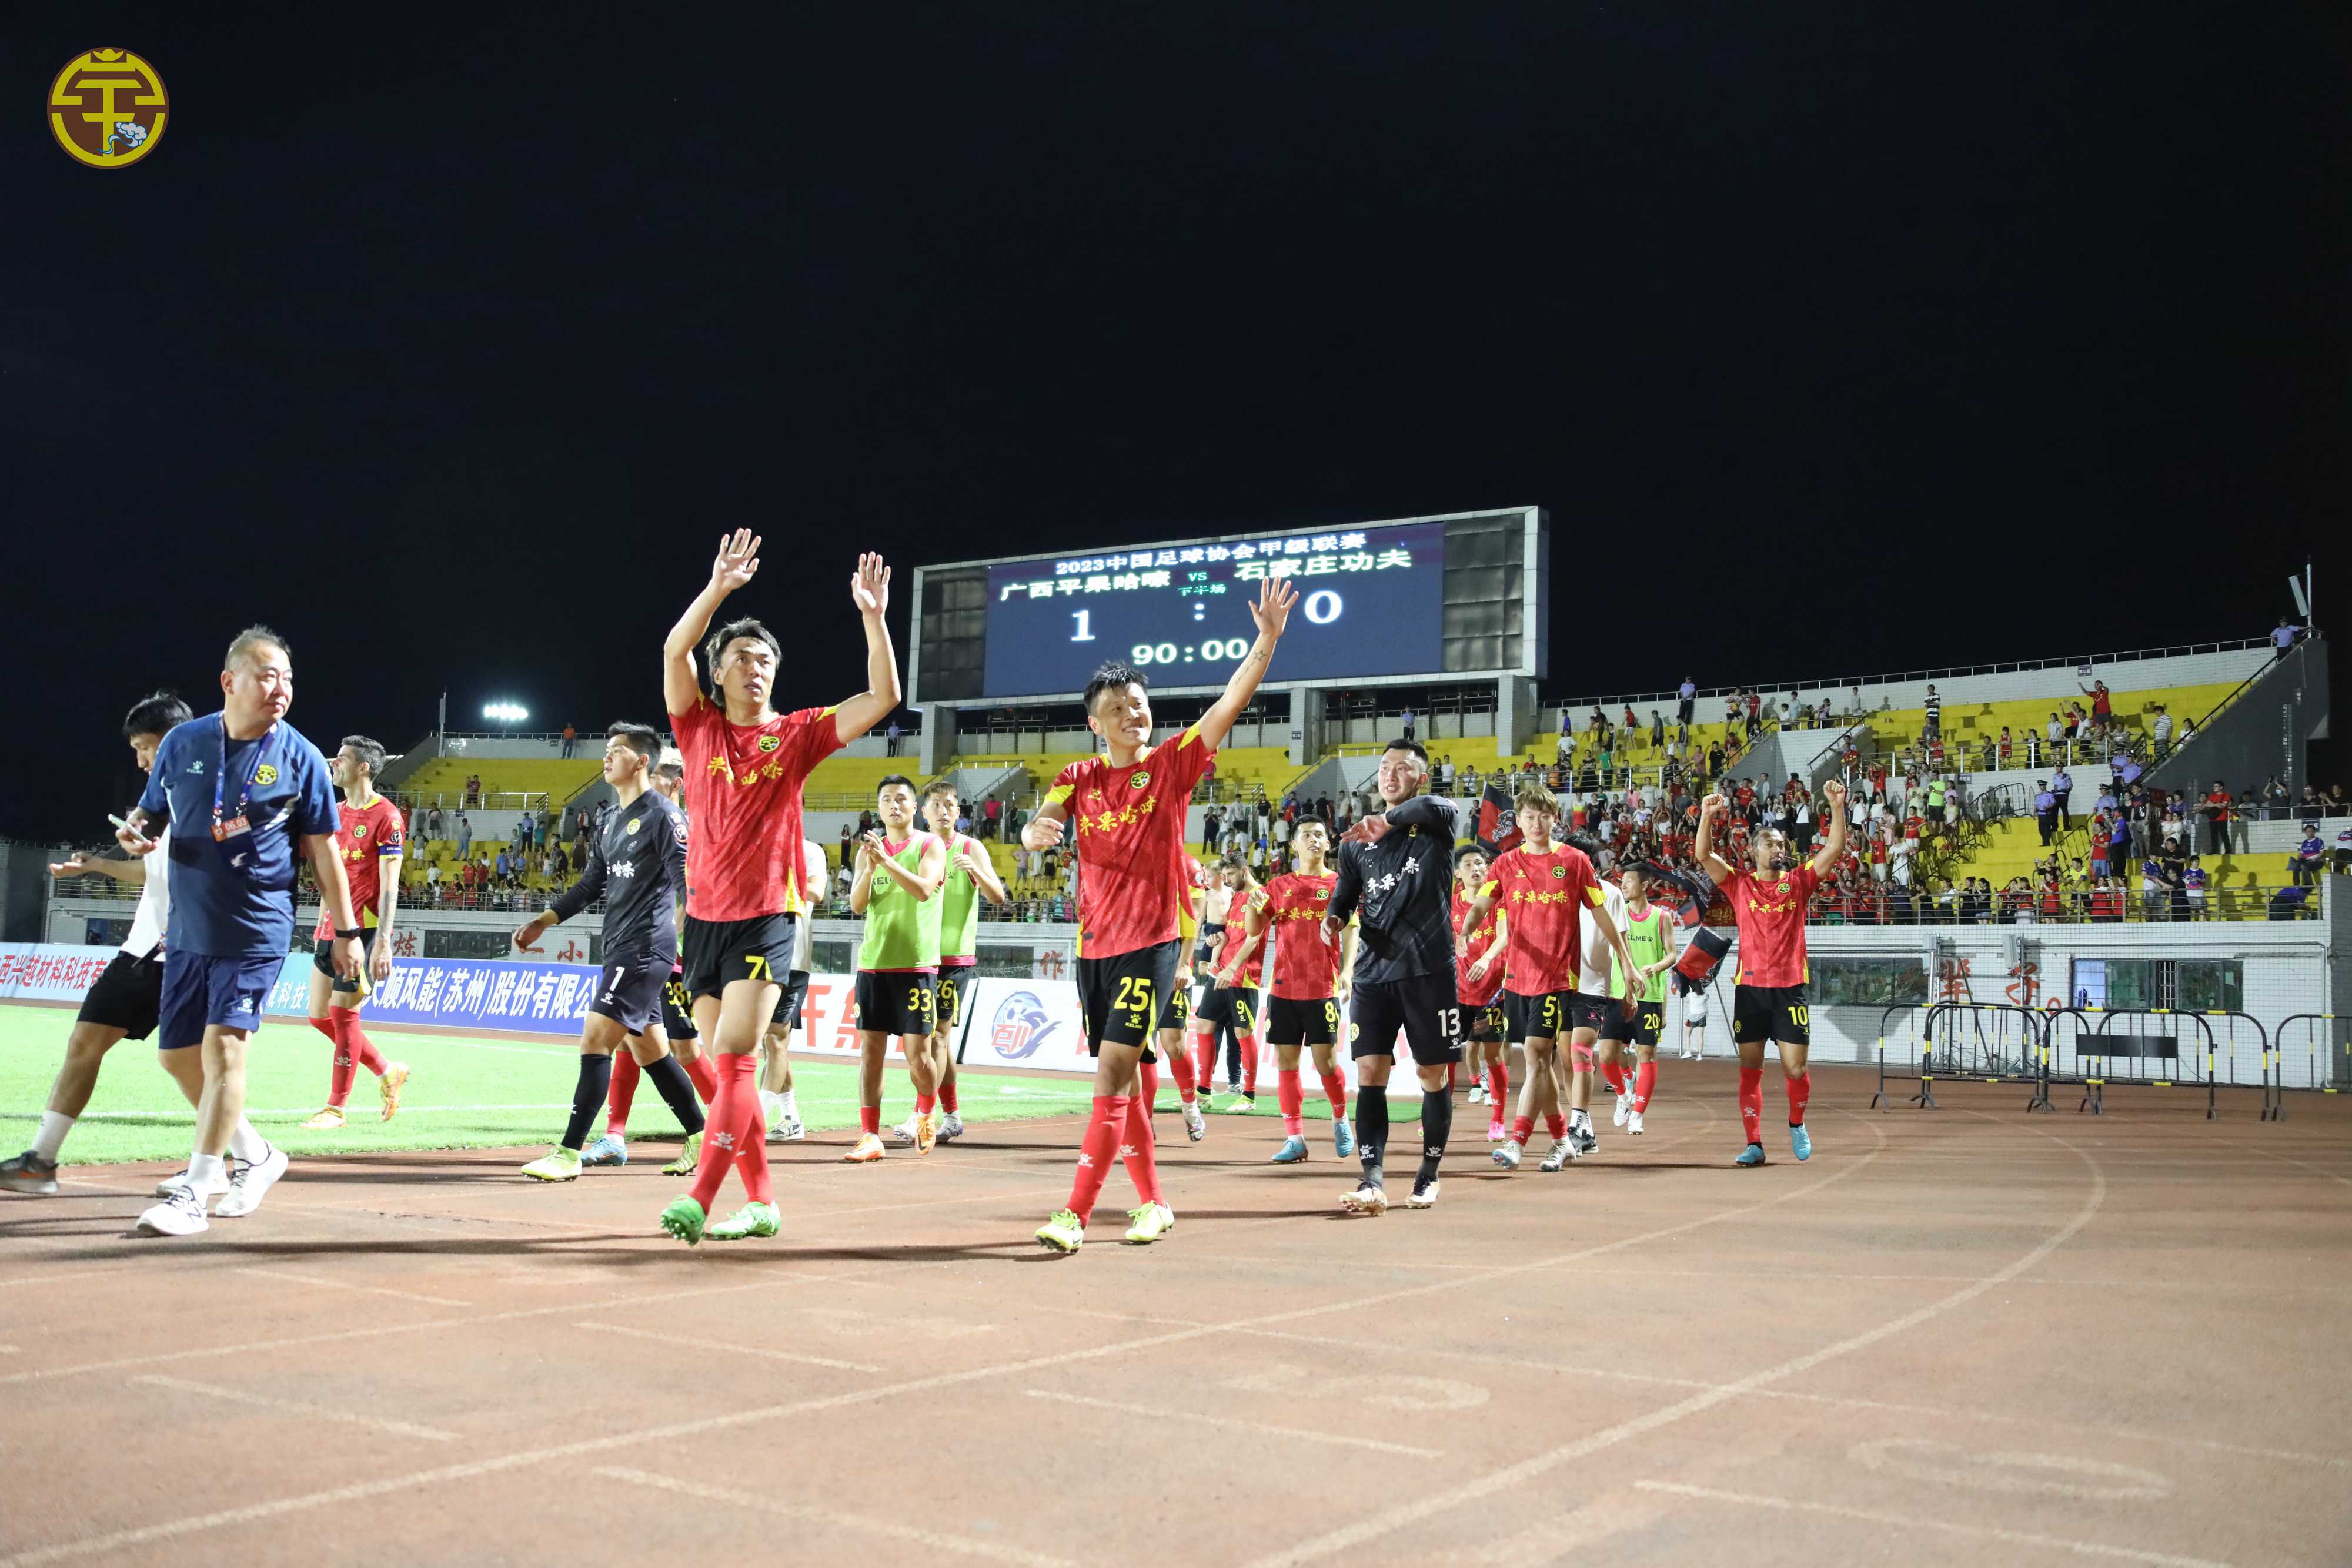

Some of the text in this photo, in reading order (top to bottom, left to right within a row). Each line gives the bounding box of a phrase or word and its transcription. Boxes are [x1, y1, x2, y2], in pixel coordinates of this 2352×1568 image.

[1056, 533, 1367, 574] 2023中国足球协会甲级联赛
[1234, 549, 1412, 581] 石家庄功夫
[1177, 584, 1226, 596] 下半场
[1071, 610, 1095, 641] 1
[1304, 590, 1343, 624] 0
[1132, 638, 1248, 666] 90:00
[1626, 934, 1647, 942] ELME
[609, 966, 625, 991] 1
[746, 955, 764, 980] 7
[908, 988, 931, 1011] 33
[1114, 977, 1151, 1012] 25
[1172, 989, 1184, 1009] 4
[1237, 1000, 1244, 1014] 9
[1325, 1001, 1336, 1022] 8
[1486, 1008, 1502, 1025] 12
[1543, 995, 1556, 1017] 5
[1788, 1006, 1808, 1025] 10
[1438, 1008, 1461, 1037] 13
[1644, 1013, 1659, 1029] 20
